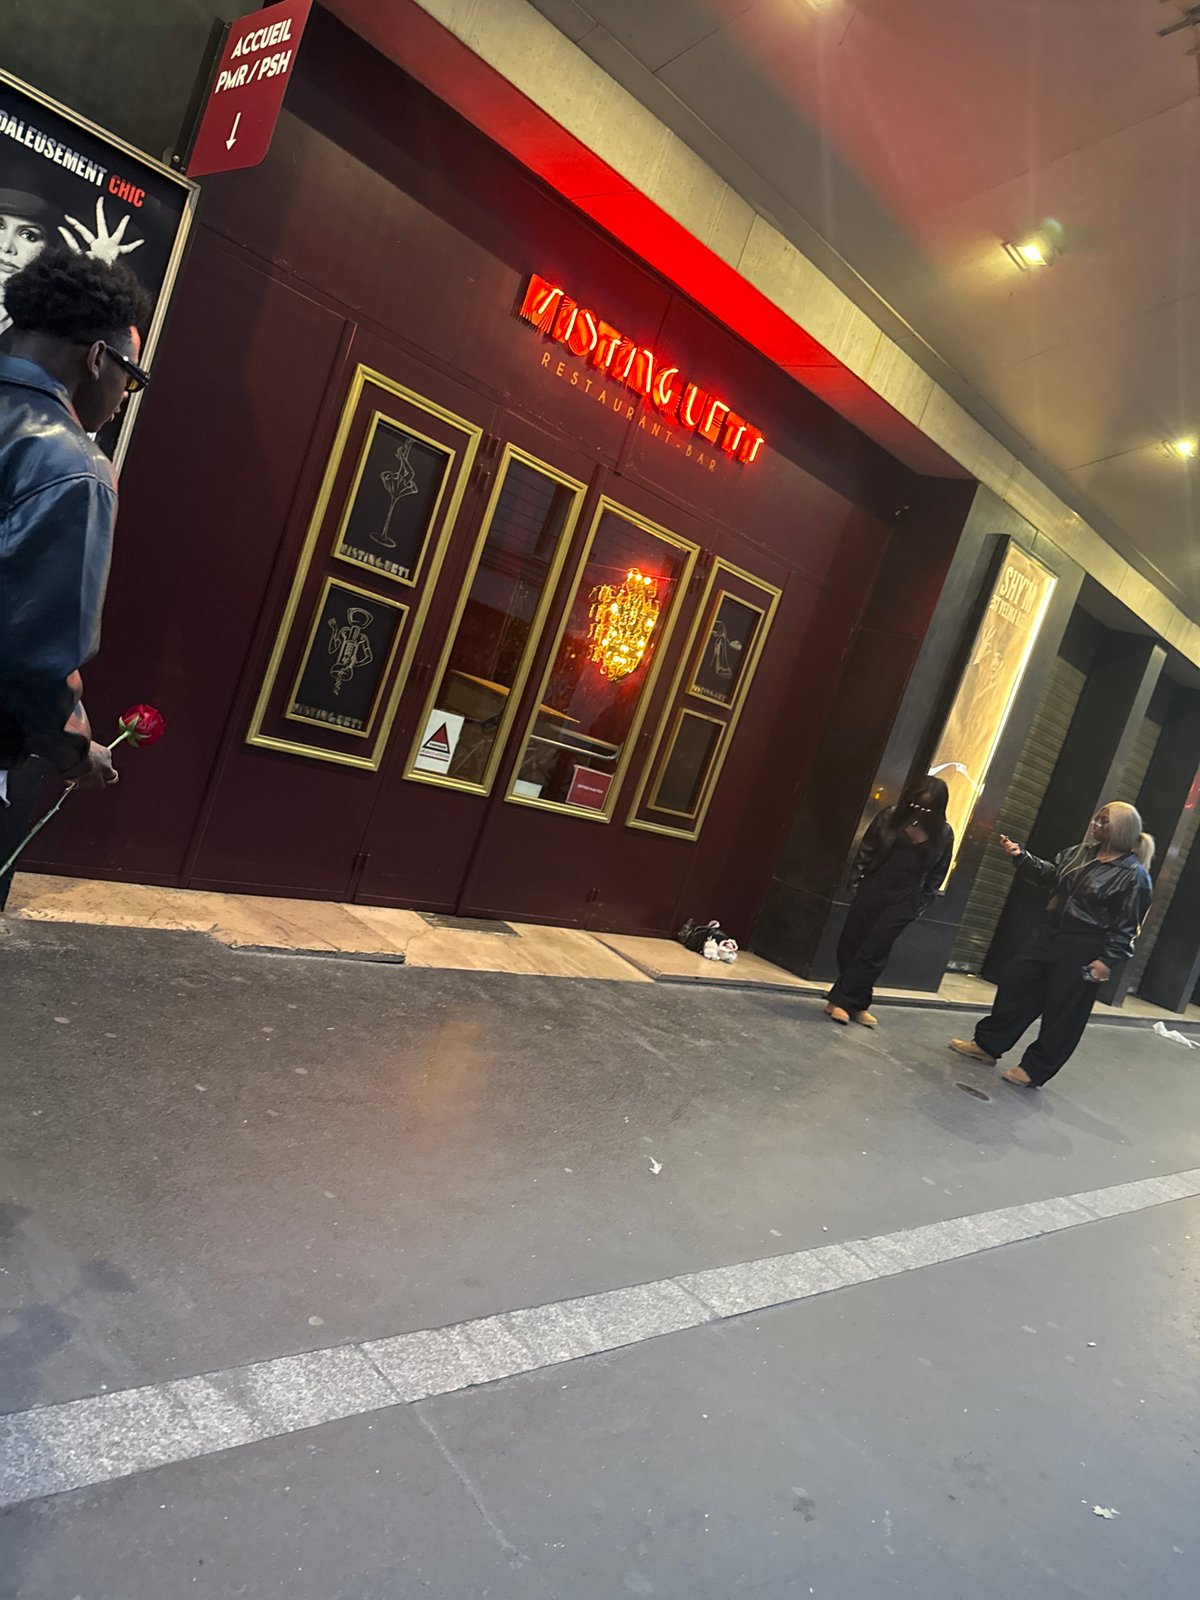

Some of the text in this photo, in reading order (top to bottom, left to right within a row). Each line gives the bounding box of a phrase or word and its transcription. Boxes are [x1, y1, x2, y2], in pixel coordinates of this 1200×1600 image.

[230, 18, 292, 59] ACCUEIL
[214, 63, 248, 94] PMR
[257, 50, 293, 82] PSH
[108, 174, 146, 208] CHIC
